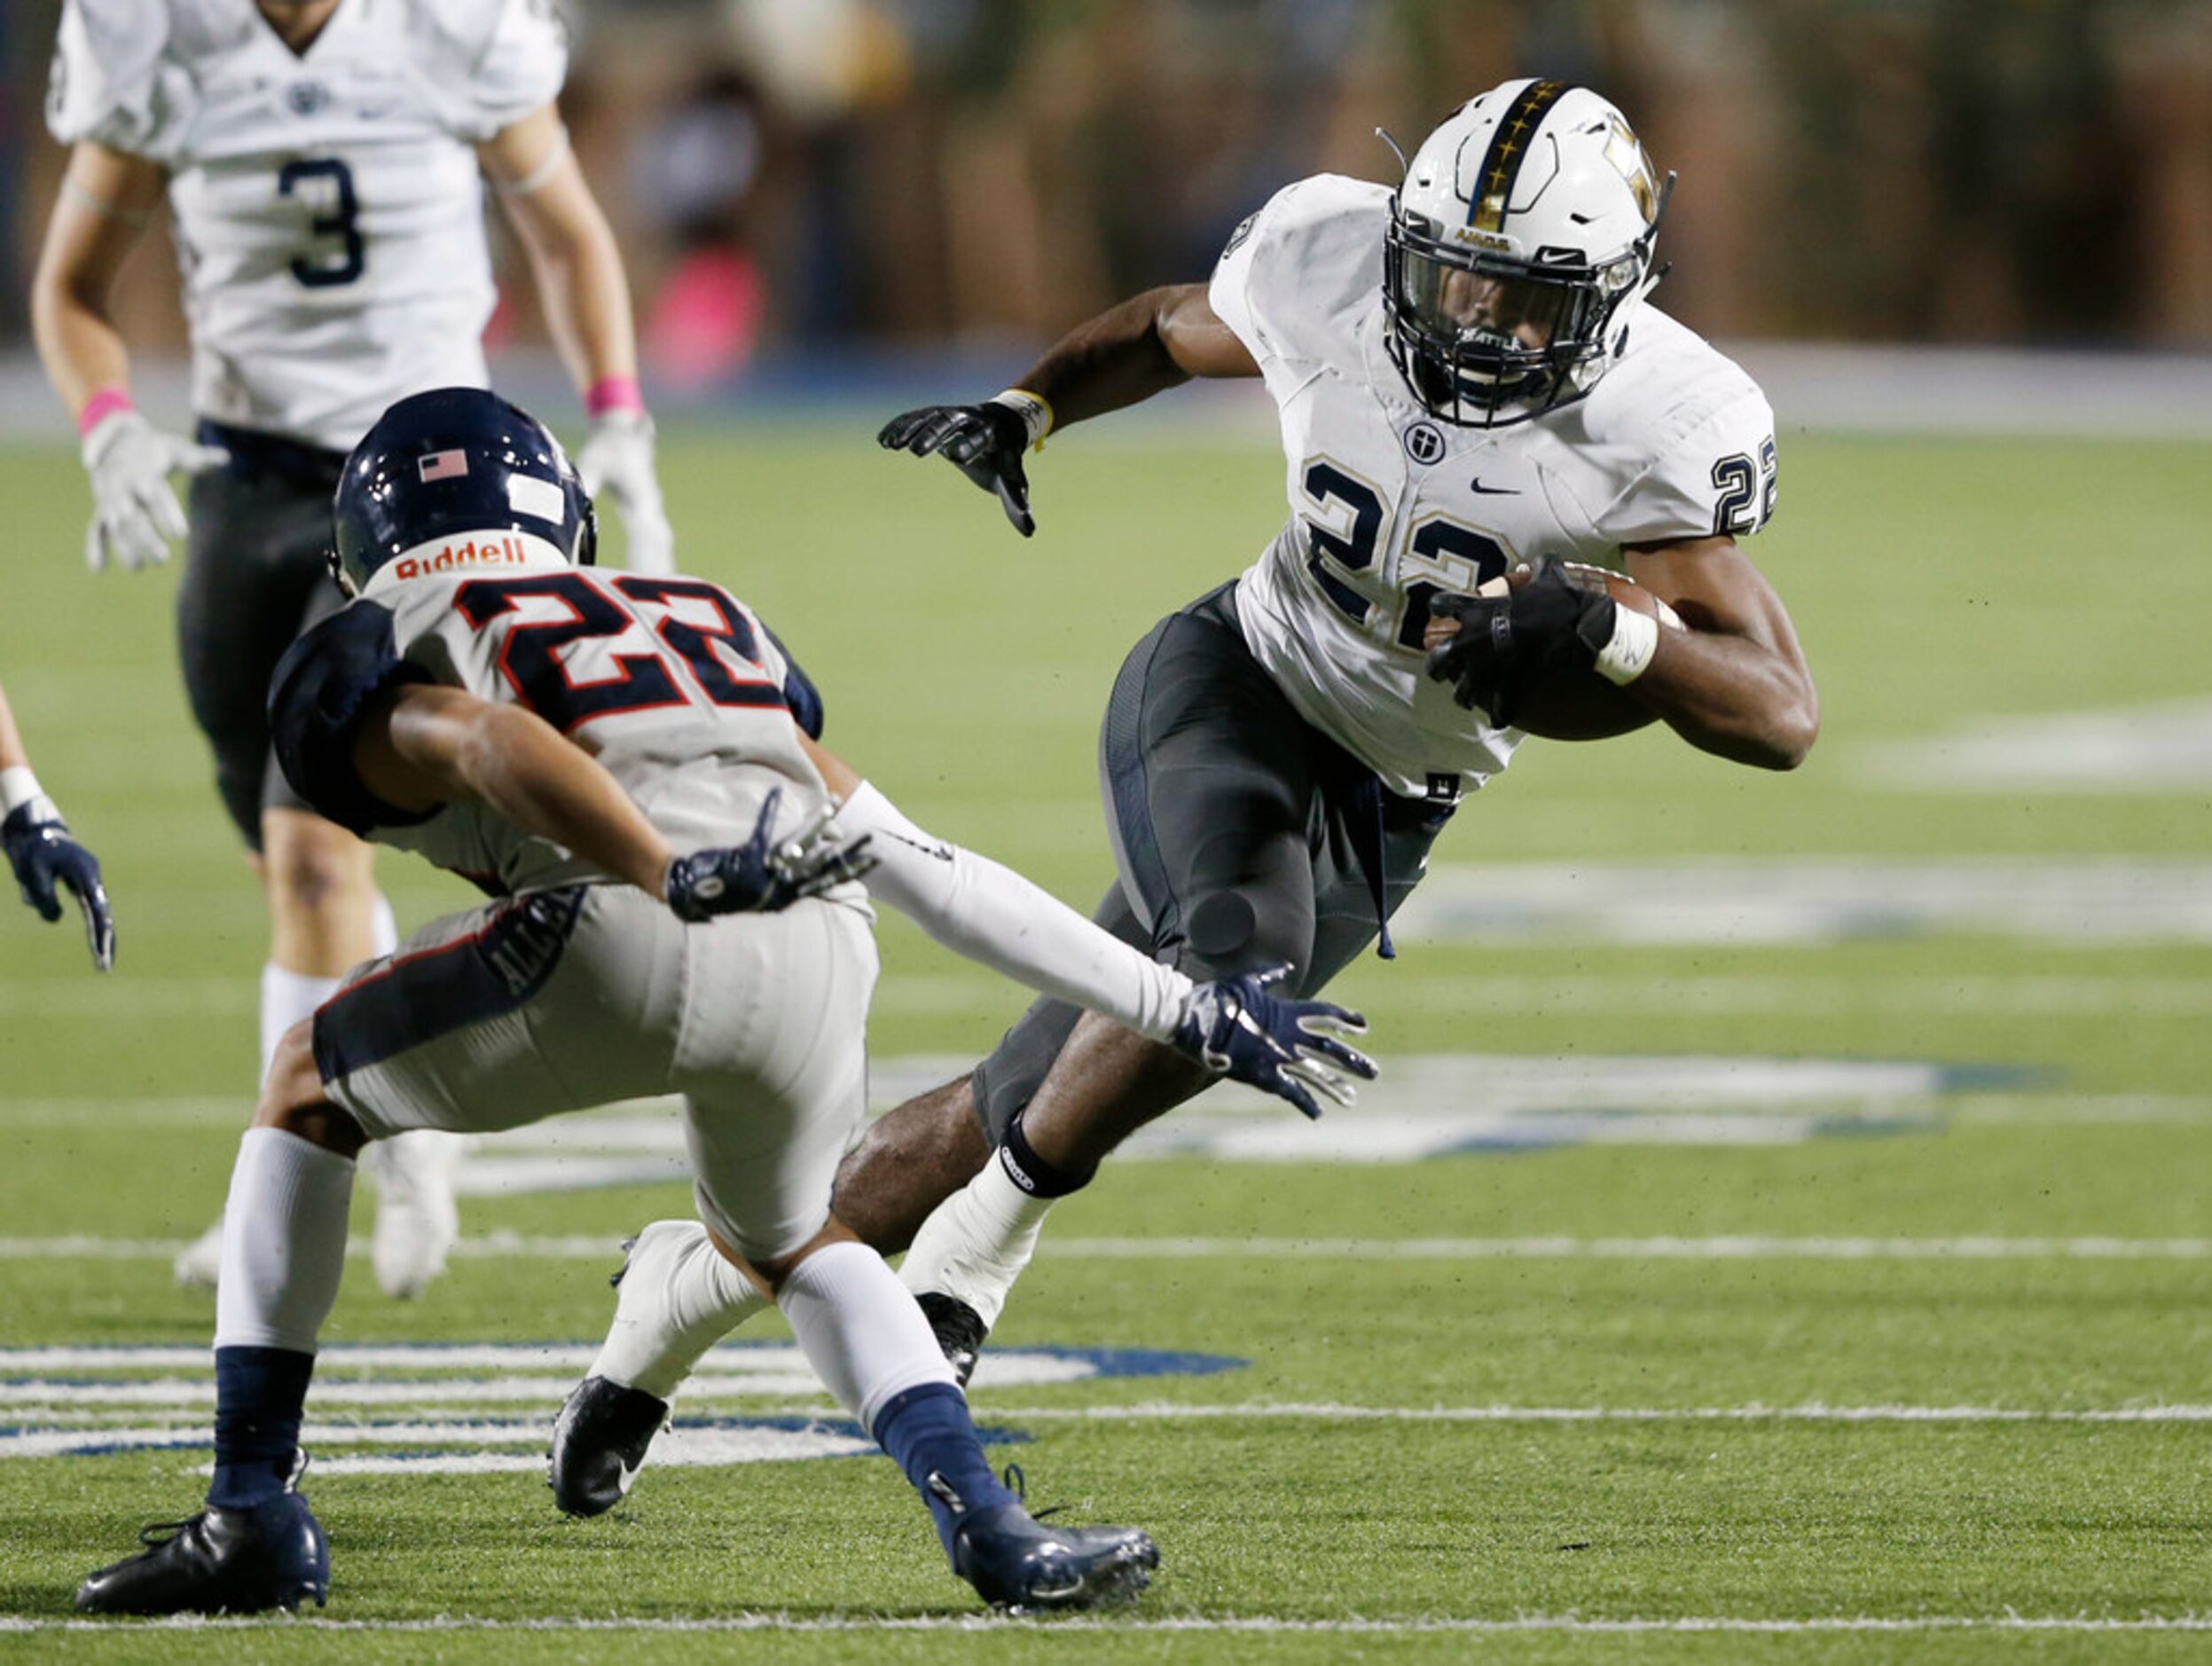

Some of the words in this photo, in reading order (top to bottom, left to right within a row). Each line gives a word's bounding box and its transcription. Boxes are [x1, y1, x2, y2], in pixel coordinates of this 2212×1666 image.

[278, 156, 365, 288] 3
[396, 537, 525, 581] Riddell
[1298, 452, 1522, 662] 22
[452, 572, 791, 734] 22
